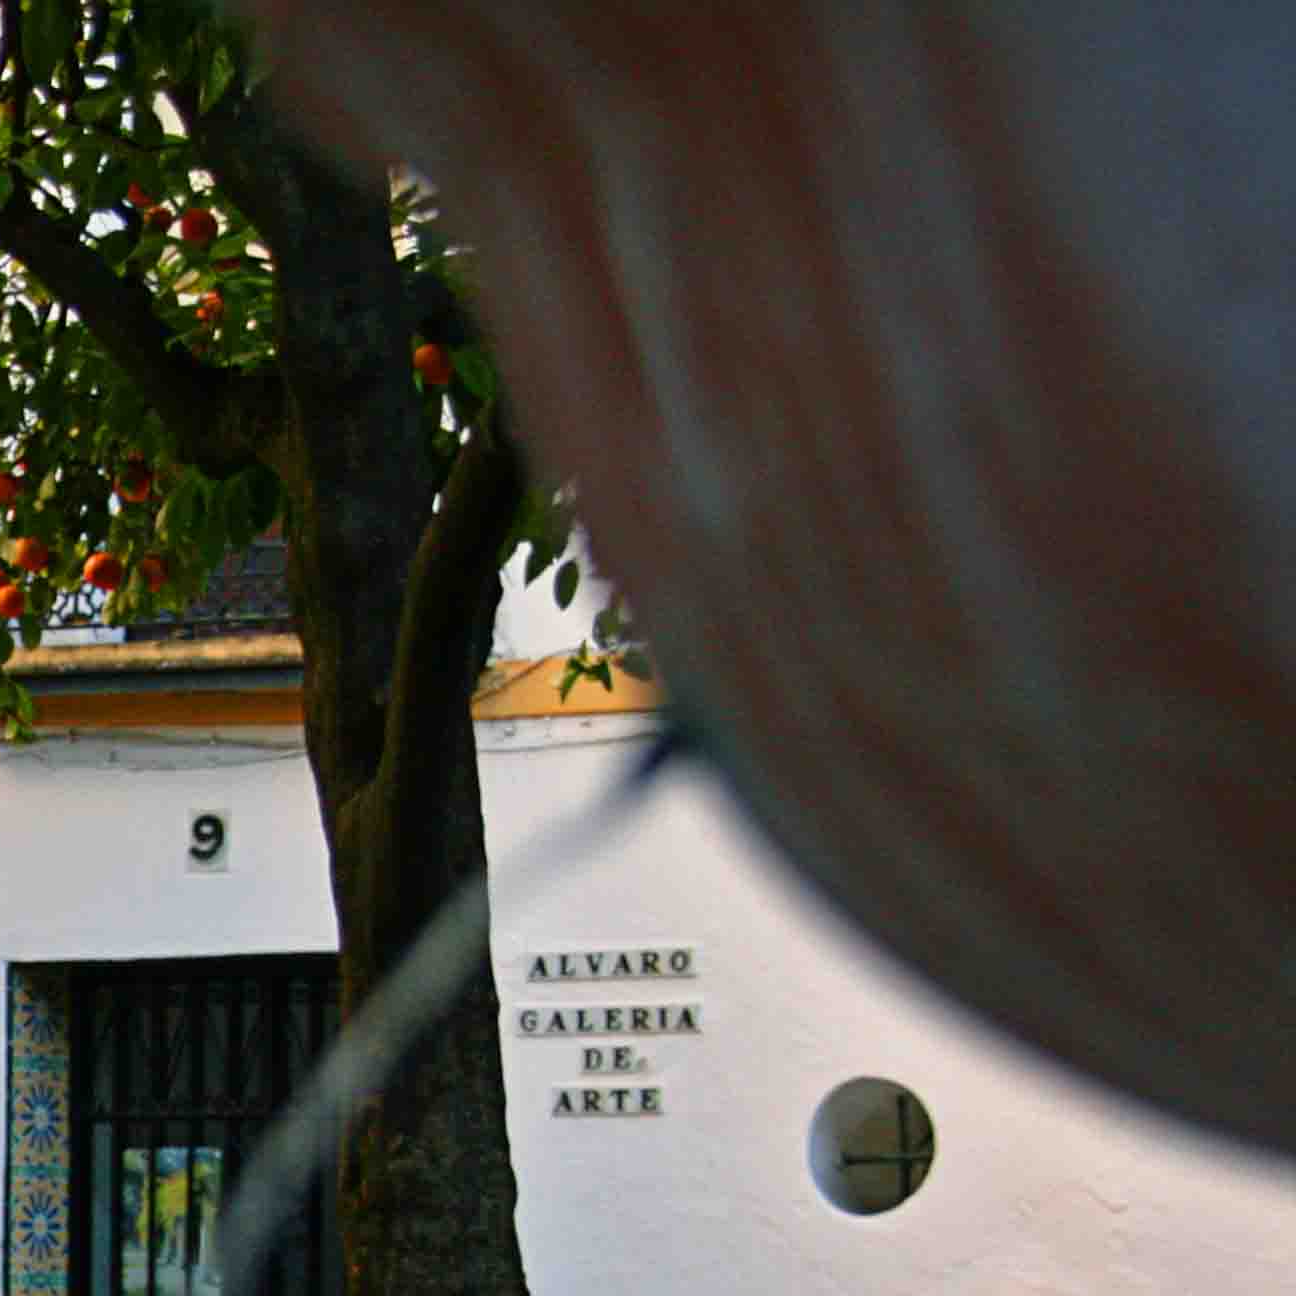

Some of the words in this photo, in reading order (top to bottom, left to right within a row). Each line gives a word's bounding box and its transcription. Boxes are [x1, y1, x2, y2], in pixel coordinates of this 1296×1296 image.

[189, 814, 224, 861] 9
[529, 951, 690, 977] ALVARO
[519, 1008, 697, 1032] GALERIA
[583, 1047, 632, 1071] DE
[553, 1088, 660, 1112] ARTE
